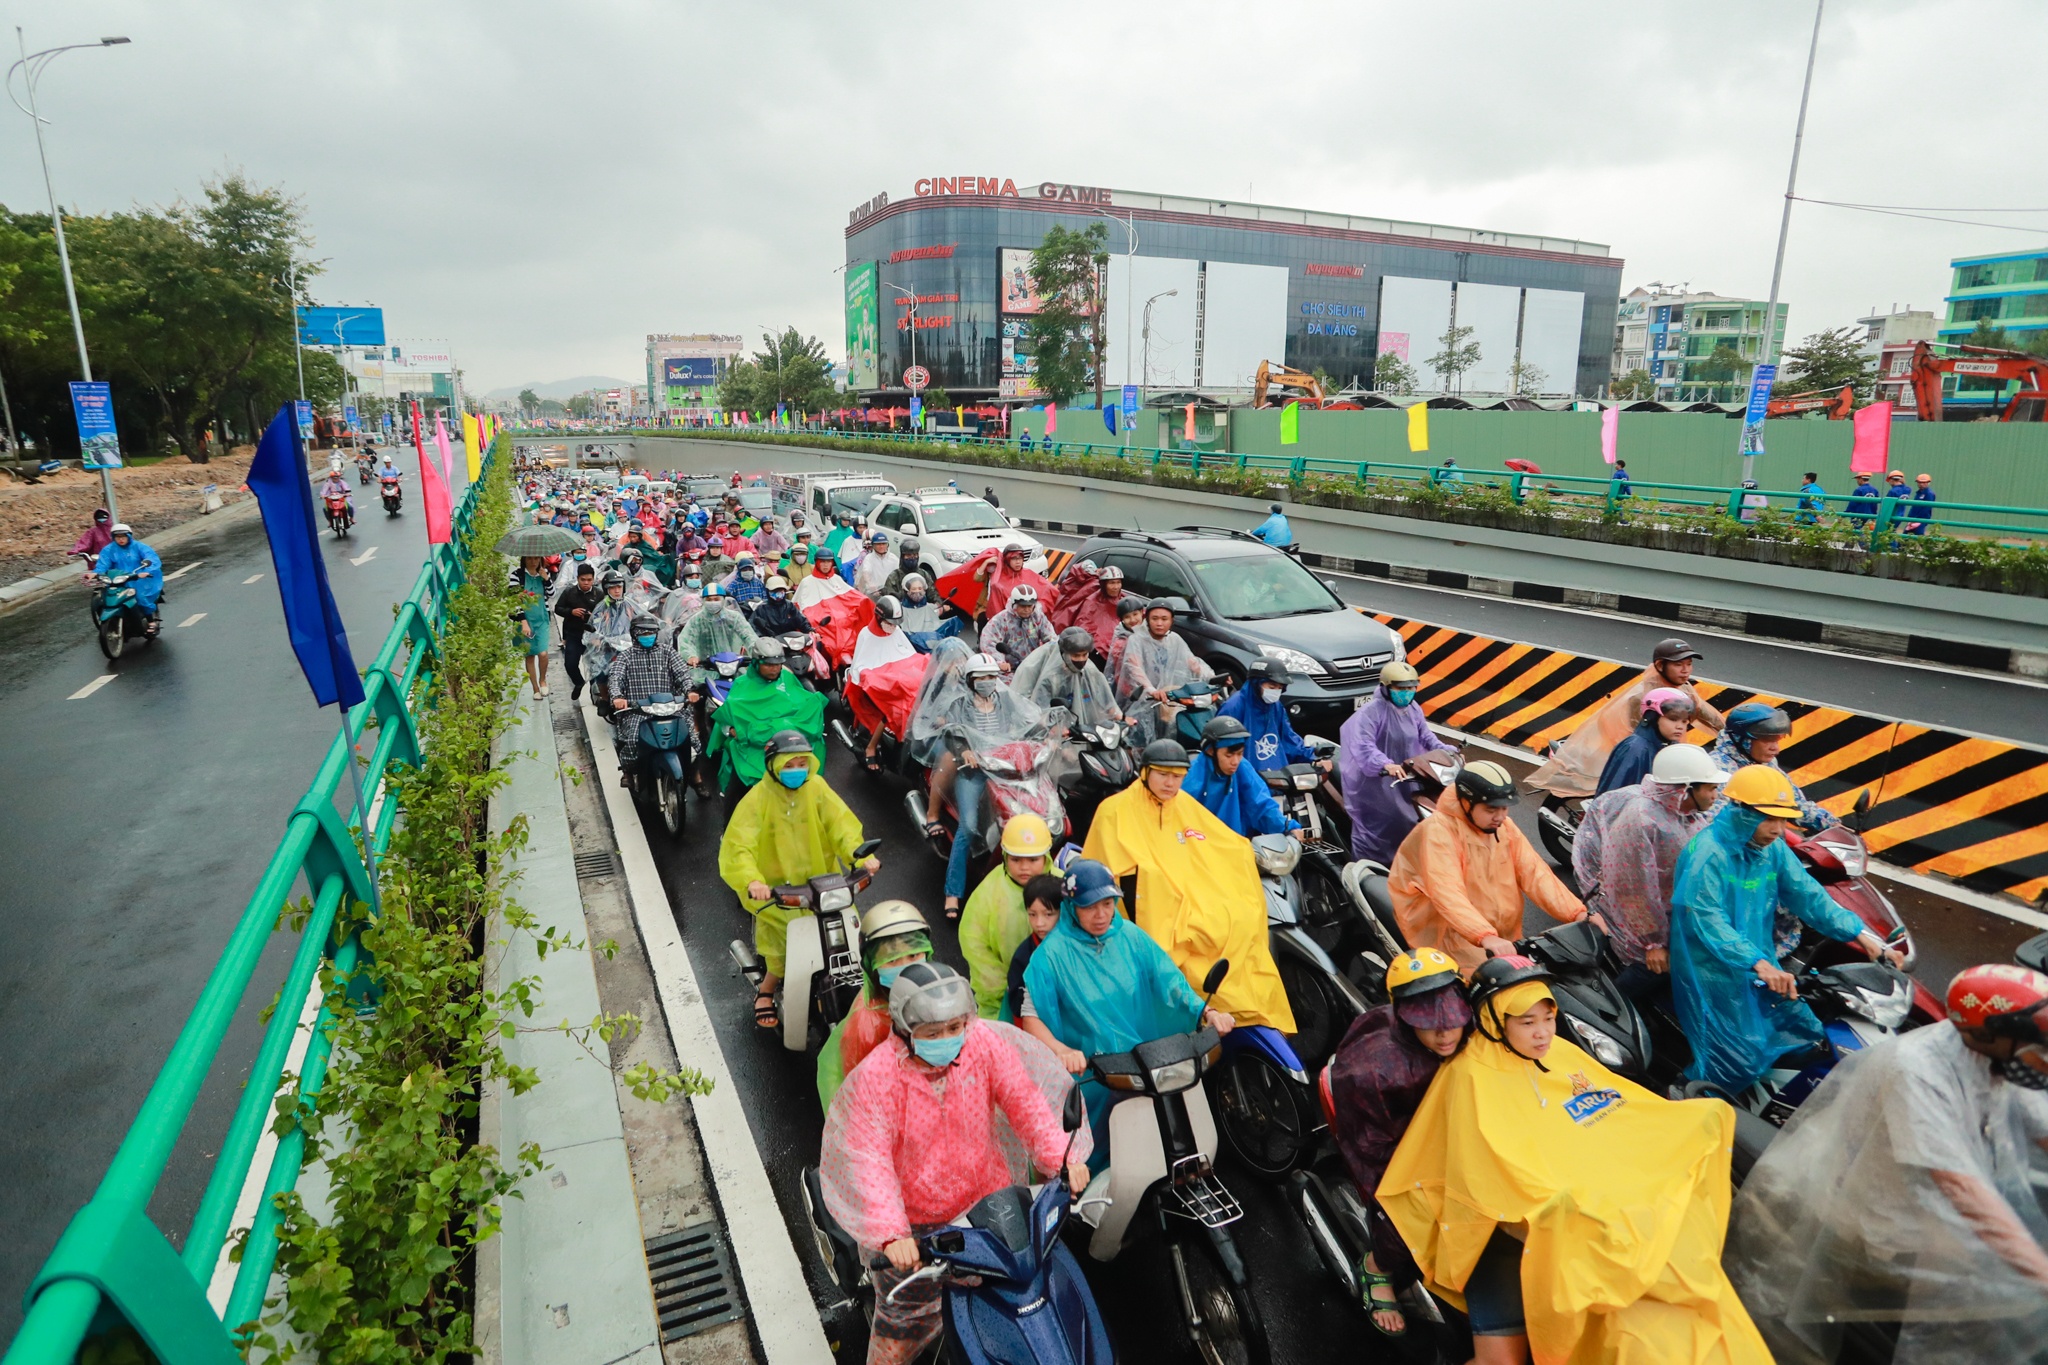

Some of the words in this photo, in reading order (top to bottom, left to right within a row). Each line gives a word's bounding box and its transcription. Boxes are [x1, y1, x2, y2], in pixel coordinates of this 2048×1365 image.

[914, 176, 1019, 198] CINEMA
[1038, 182, 1112, 206] GAME
[849, 191, 888, 225] BOWLING
[1008, 301, 1032, 311] GAME
[1301, 301, 1326, 317] CHỢ
[1327, 302, 1350, 317] SIÊU
[1351, 305, 1366, 319] THỊ
[1308, 320, 1323, 335] ĐÀ
[1324, 319, 1358, 336] NẴNG
[1017, 1296, 1045, 1315] HONDA
